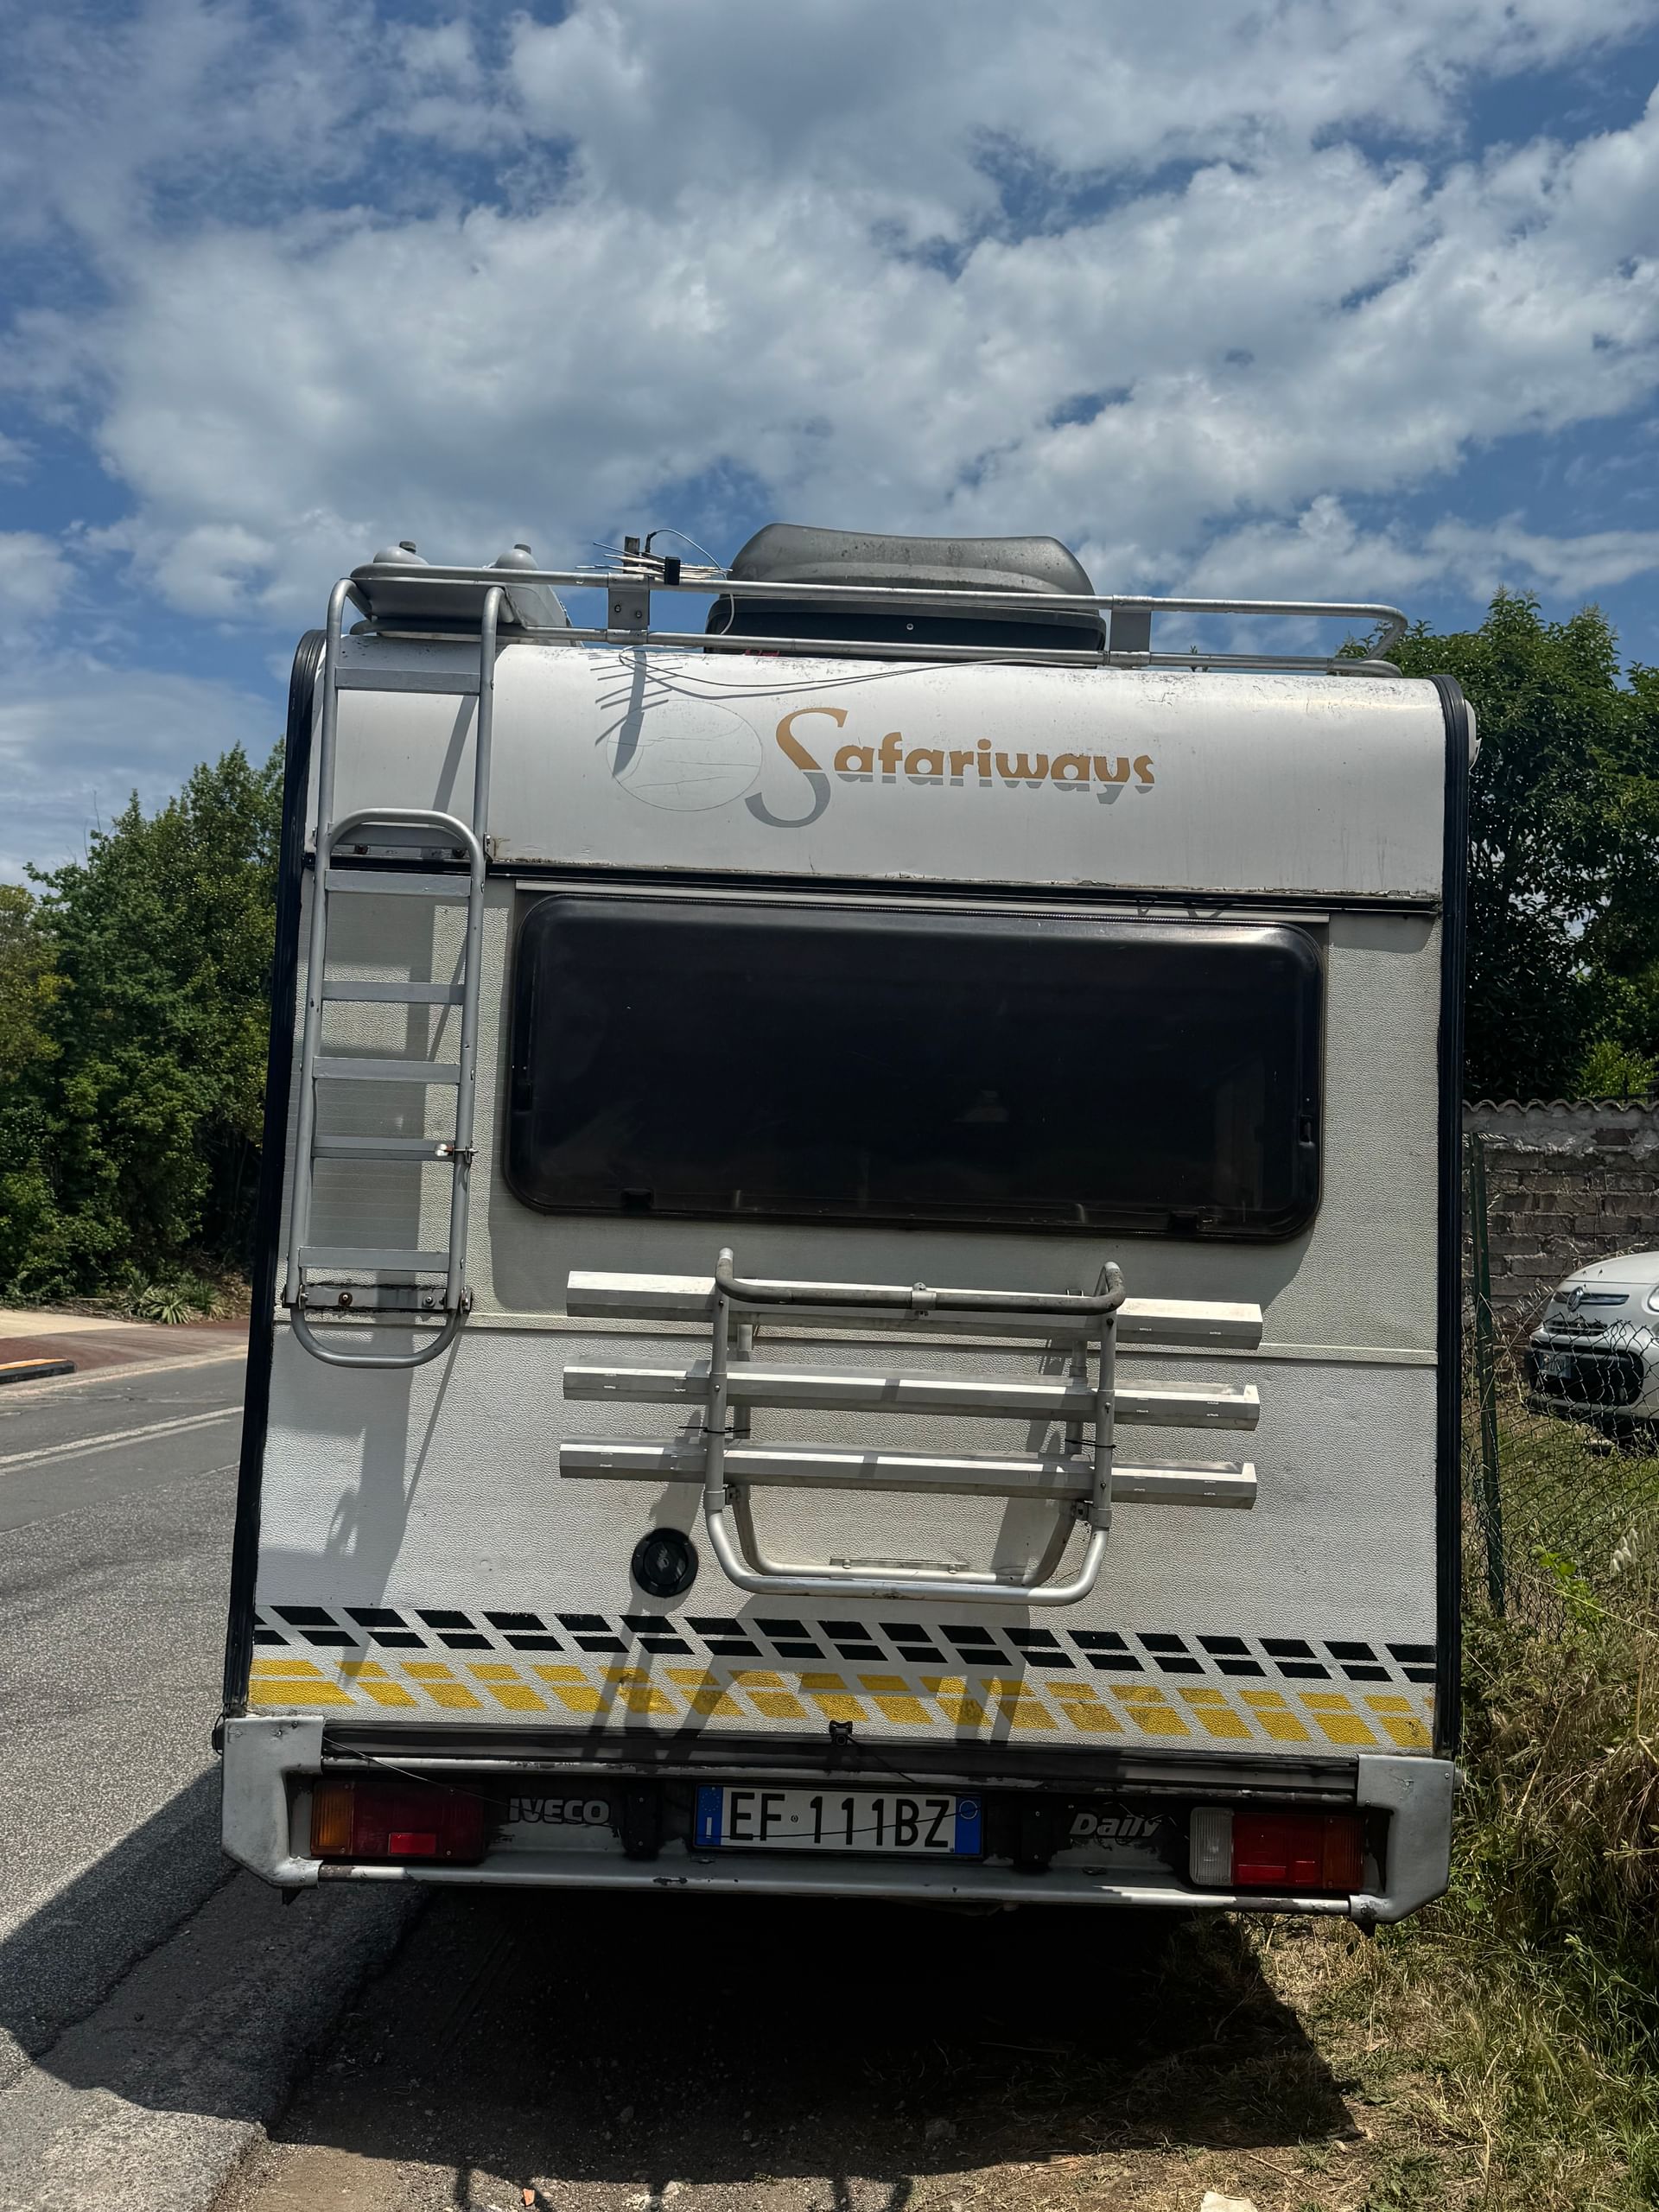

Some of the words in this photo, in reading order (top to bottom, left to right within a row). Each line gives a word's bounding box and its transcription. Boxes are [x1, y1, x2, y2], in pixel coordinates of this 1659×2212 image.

[745, 707, 1155, 828] Safariways
[509, 1797, 610, 1824] IVECO
[729, 1791, 785, 1841] EF
[810, 1796, 950, 1848] 111BZ
[1069, 1813, 1162, 1837] Daily
